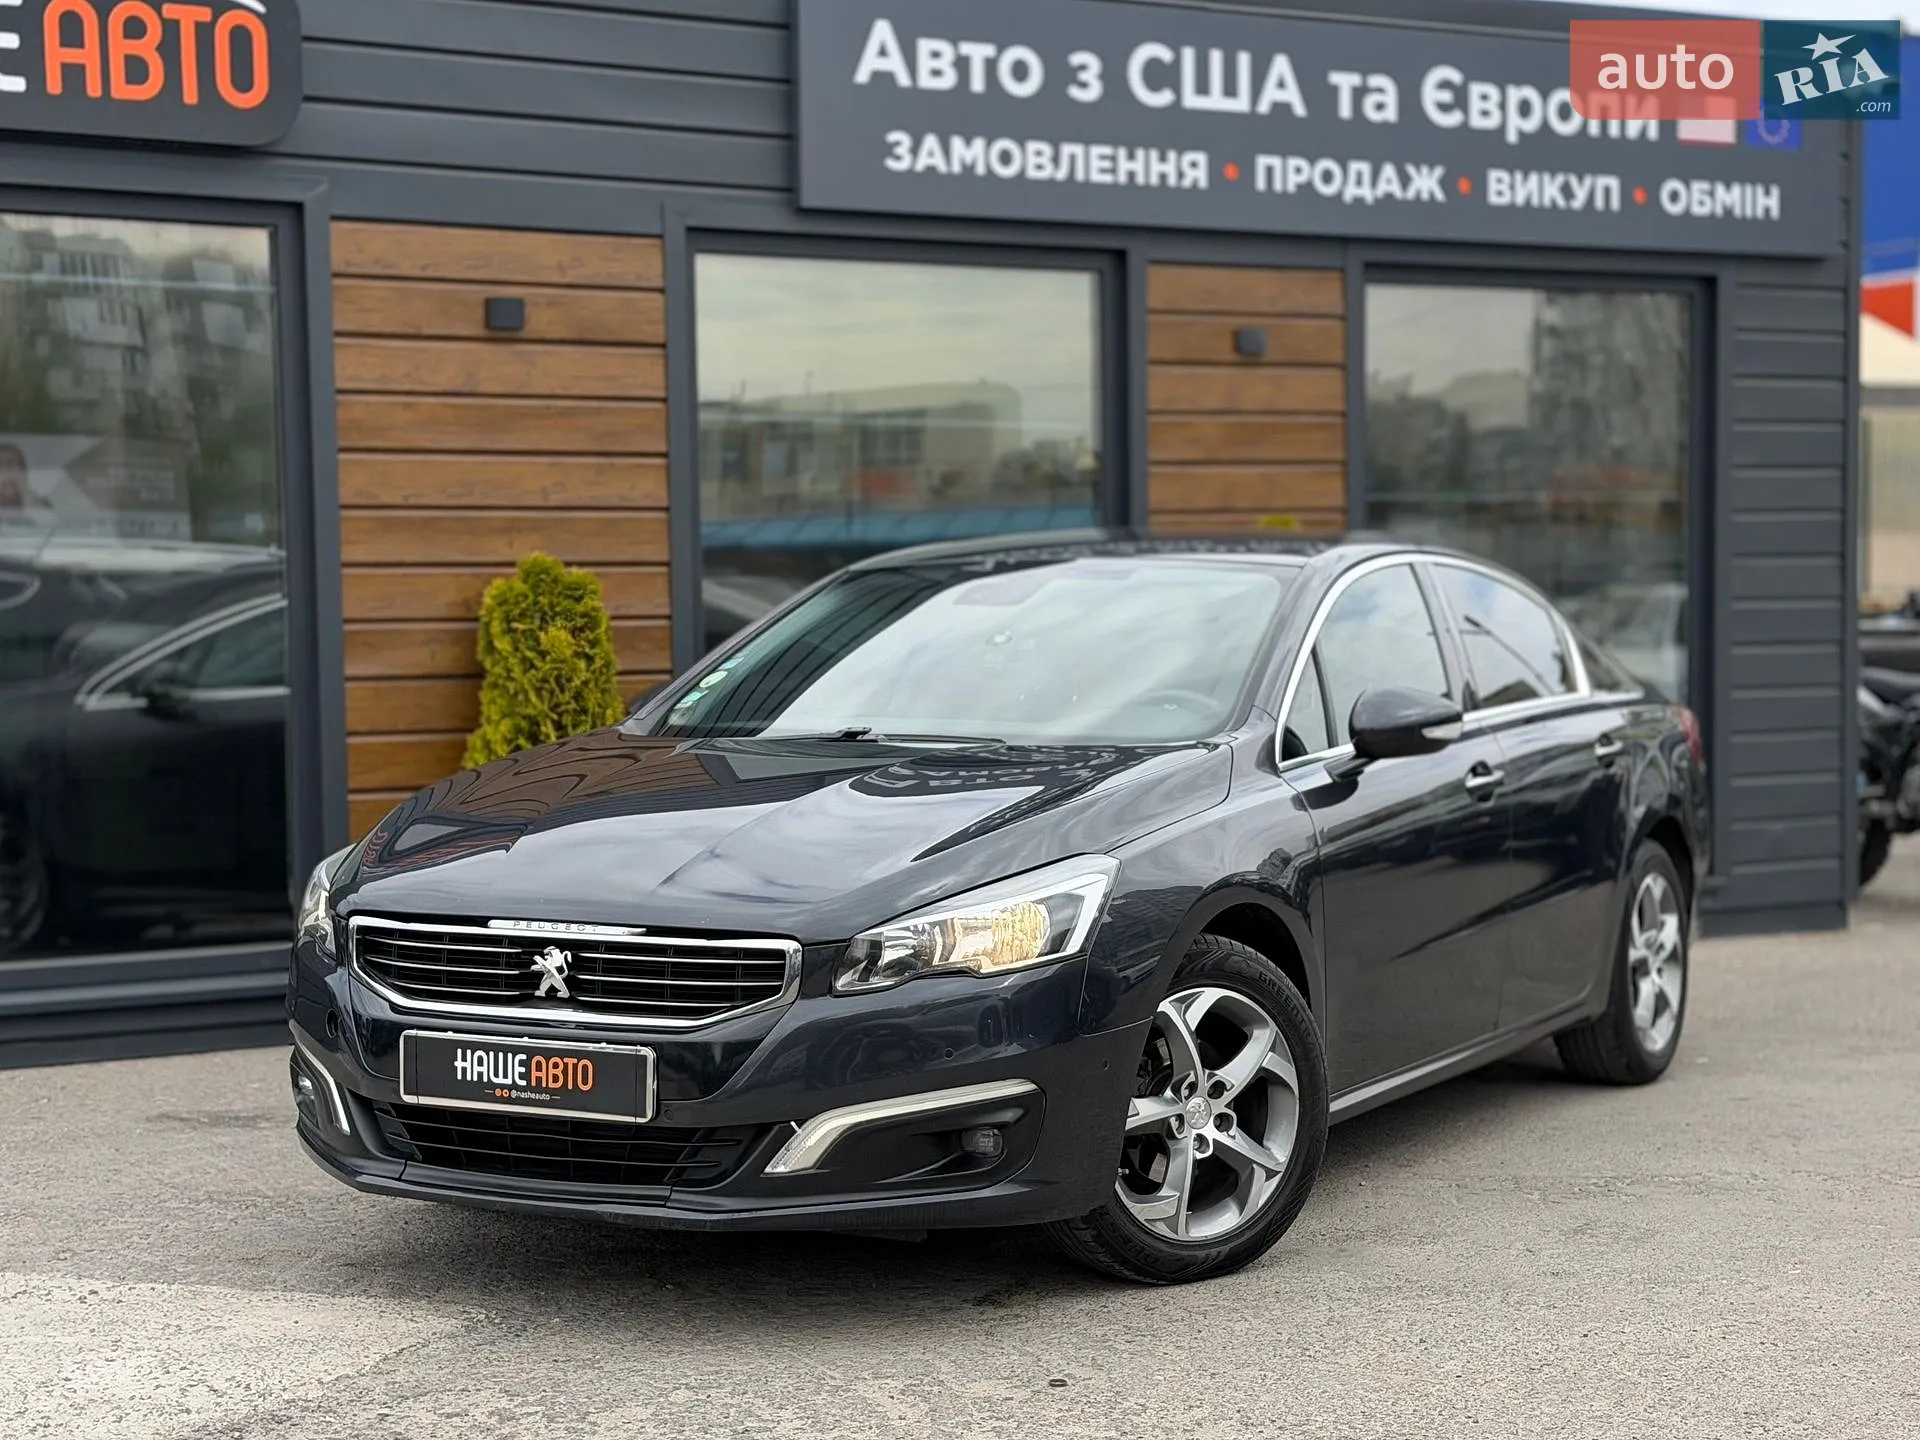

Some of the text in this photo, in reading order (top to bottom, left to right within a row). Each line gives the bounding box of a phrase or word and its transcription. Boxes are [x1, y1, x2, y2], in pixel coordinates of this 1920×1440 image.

[43, 0, 270, 110] АВТО
[853, 18, 1660, 145] Авто з США та Європи
[883, 130, 1782, 221] ЗАМОВЛЕННЯ ПРОДАЖ ВИКУП ОБМІН
[512, 920, 600, 932] PEUGEOT
[454, 1048, 594, 1092] НАШЕ АВТО
[510, 1088, 551, 1101] @nasheauto
